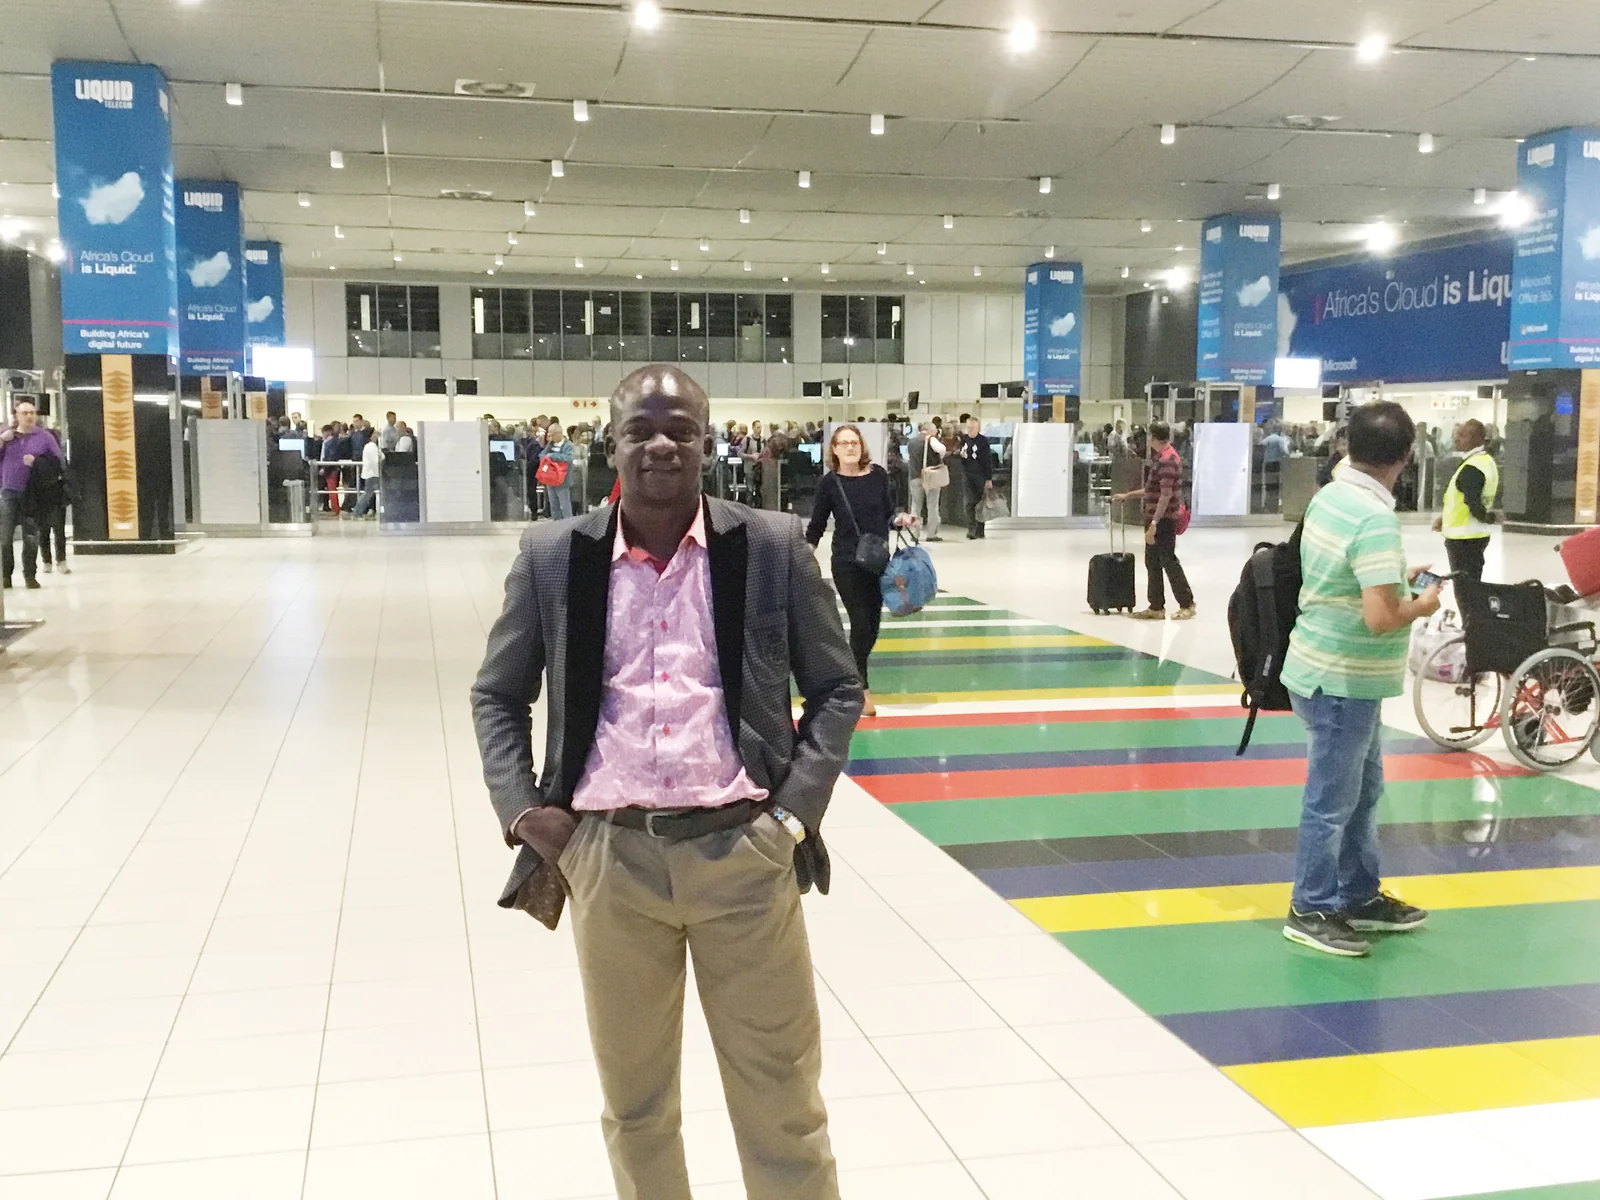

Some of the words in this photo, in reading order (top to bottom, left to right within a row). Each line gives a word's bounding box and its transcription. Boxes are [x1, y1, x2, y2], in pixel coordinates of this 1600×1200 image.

[75, 79, 133, 103] LIQUID
[104, 101, 132, 109] TELECOM
[184, 192, 223, 208] LIQUID
[80, 250, 118, 261] Africa's
[121, 251, 153, 263] Cloud
[81, 263, 92, 274] is
[95, 263, 136, 276] Liquid.
[1323, 286, 1379, 320] Africa's
[1384, 276, 1437, 313] Cloud
[1442, 274, 1461, 305] is
[80, 329, 115, 339] Building
[117, 329, 149, 338] Africa's
[88, 340, 114, 350] digital
[117, 341, 142, 349] future
[1323, 357, 1358, 371] Microsoft
